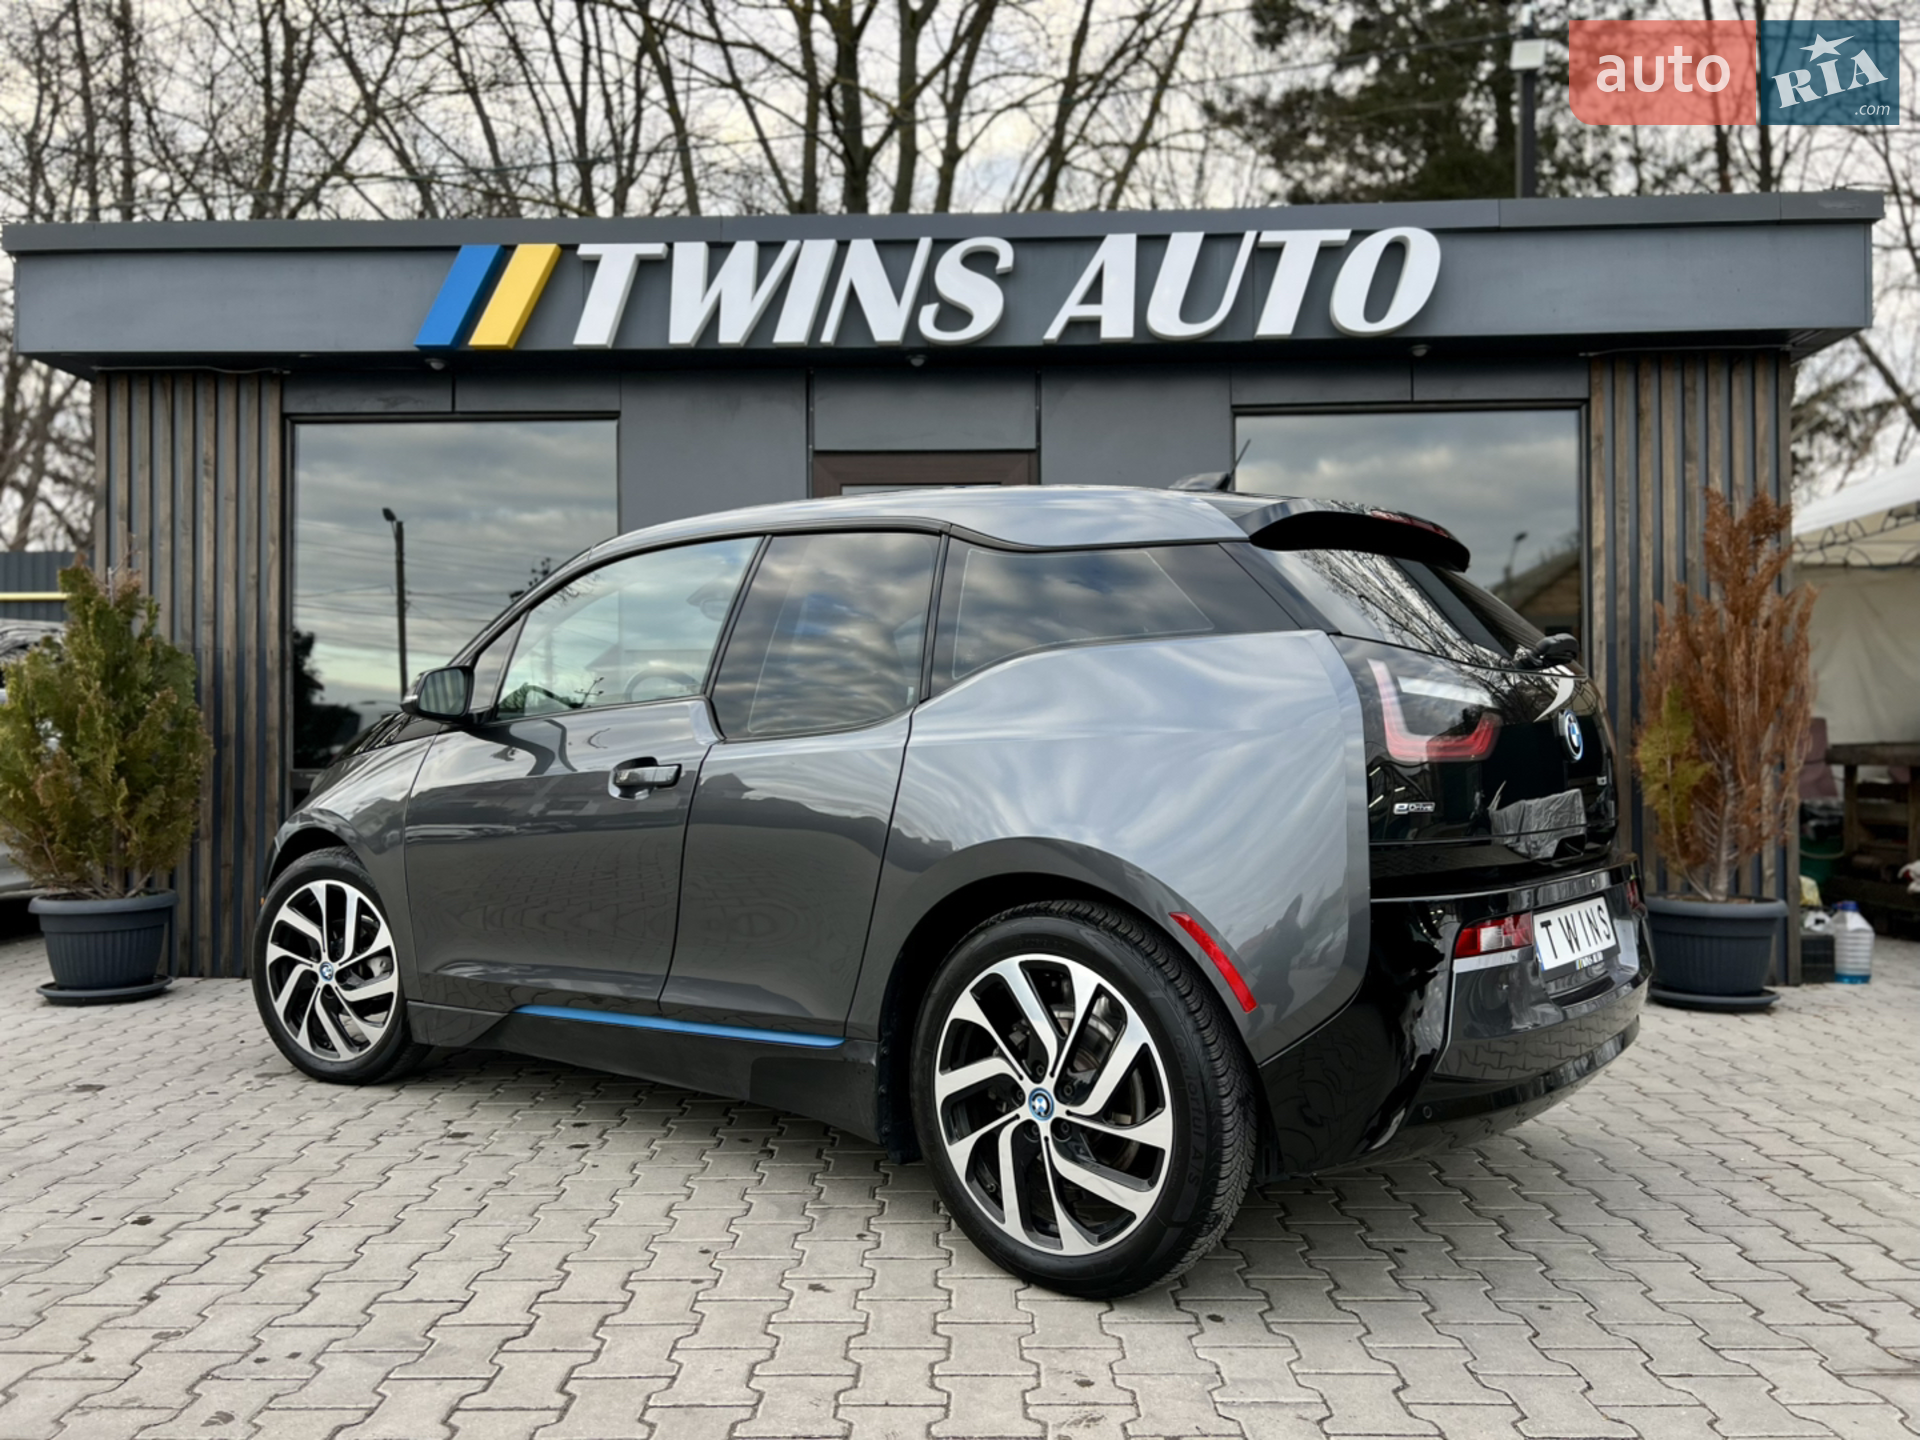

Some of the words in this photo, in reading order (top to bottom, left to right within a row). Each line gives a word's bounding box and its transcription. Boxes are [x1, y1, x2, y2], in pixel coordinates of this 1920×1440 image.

[572, 236, 1015, 348] TWINS
[1042, 226, 1442, 345] AUTO
[1540, 904, 1611, 959] TWINS
